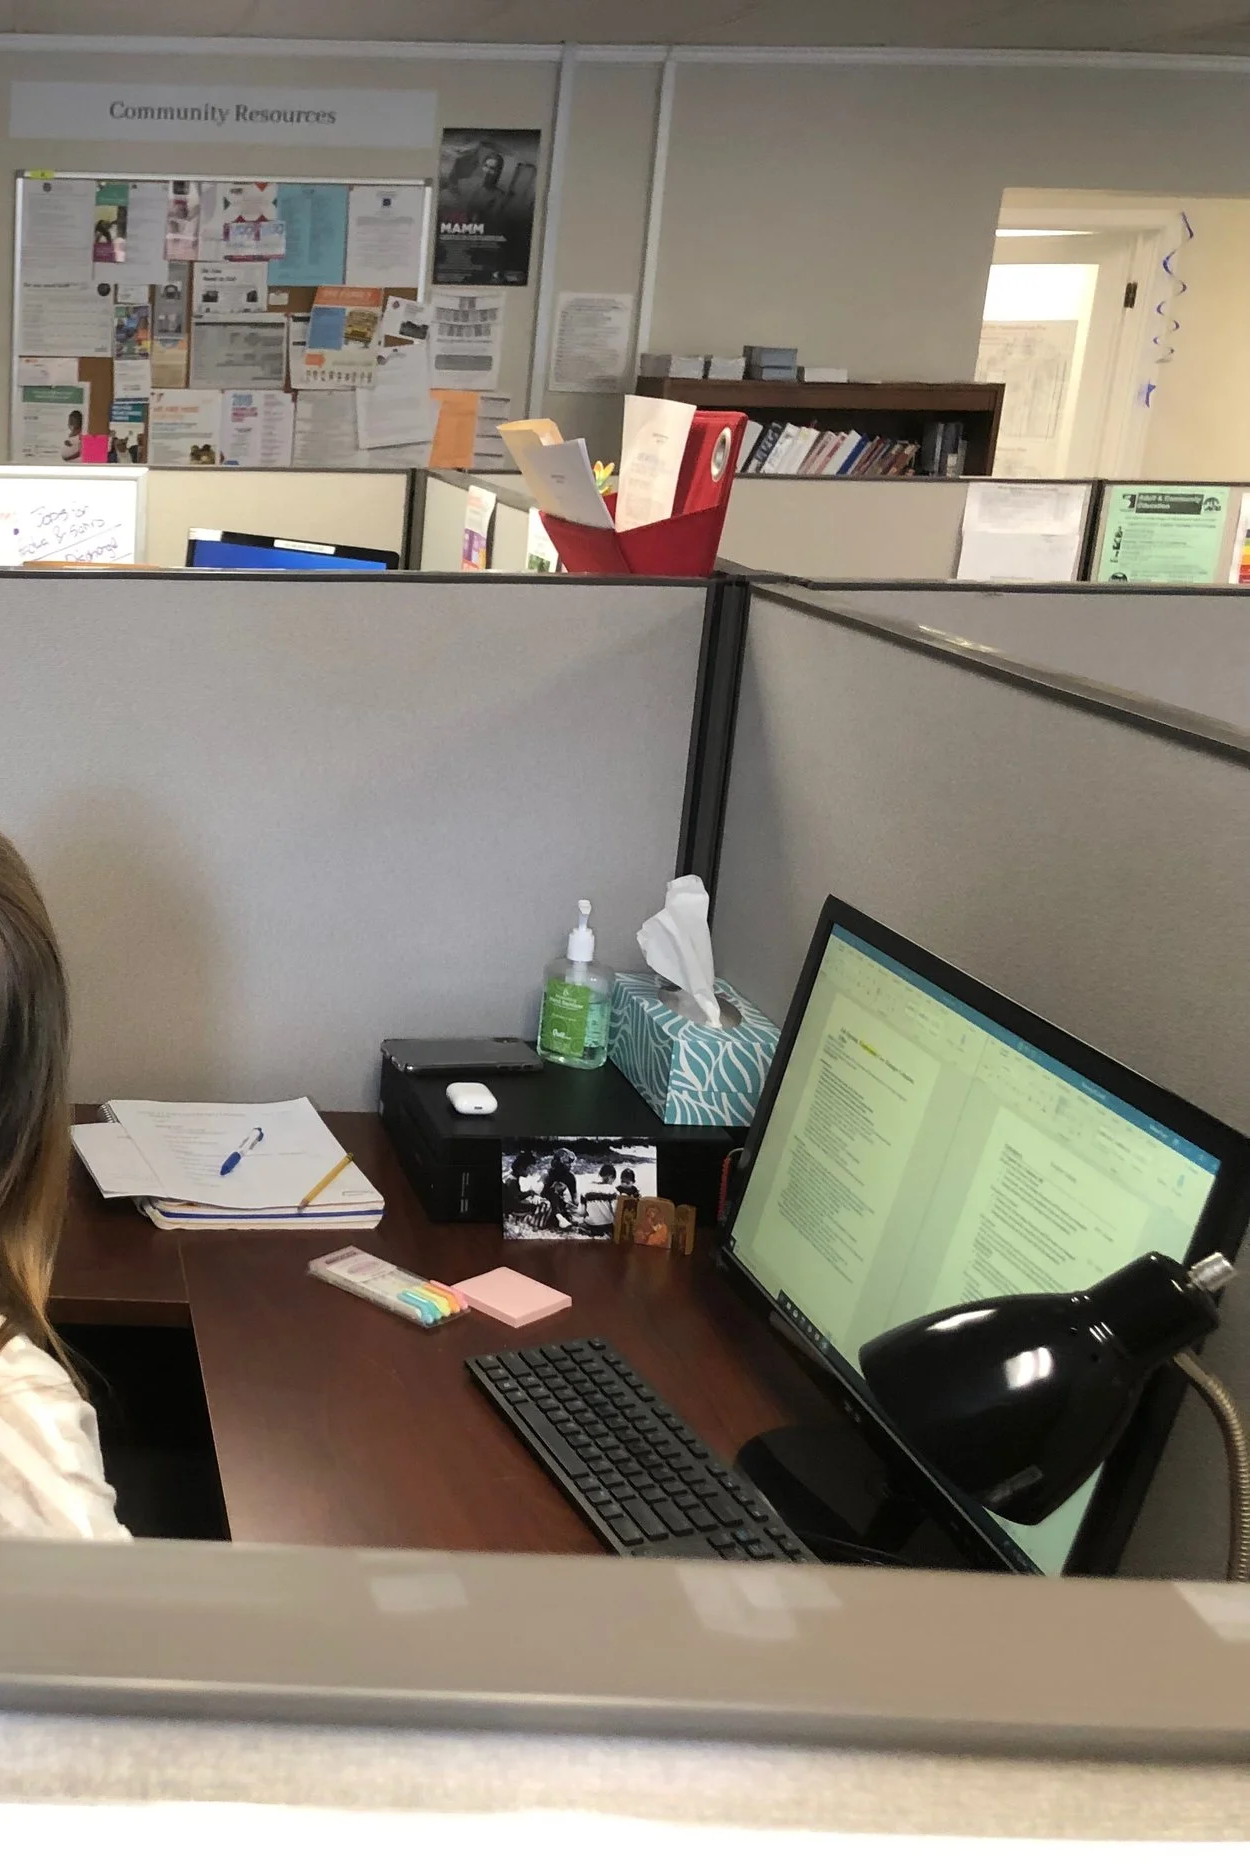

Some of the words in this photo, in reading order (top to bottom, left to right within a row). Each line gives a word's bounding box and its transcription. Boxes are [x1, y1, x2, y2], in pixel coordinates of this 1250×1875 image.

[109, 100, 230, 127] Community
[235, 104, 338, 125] Resources
[440, 222, 485, 235] MAMM
